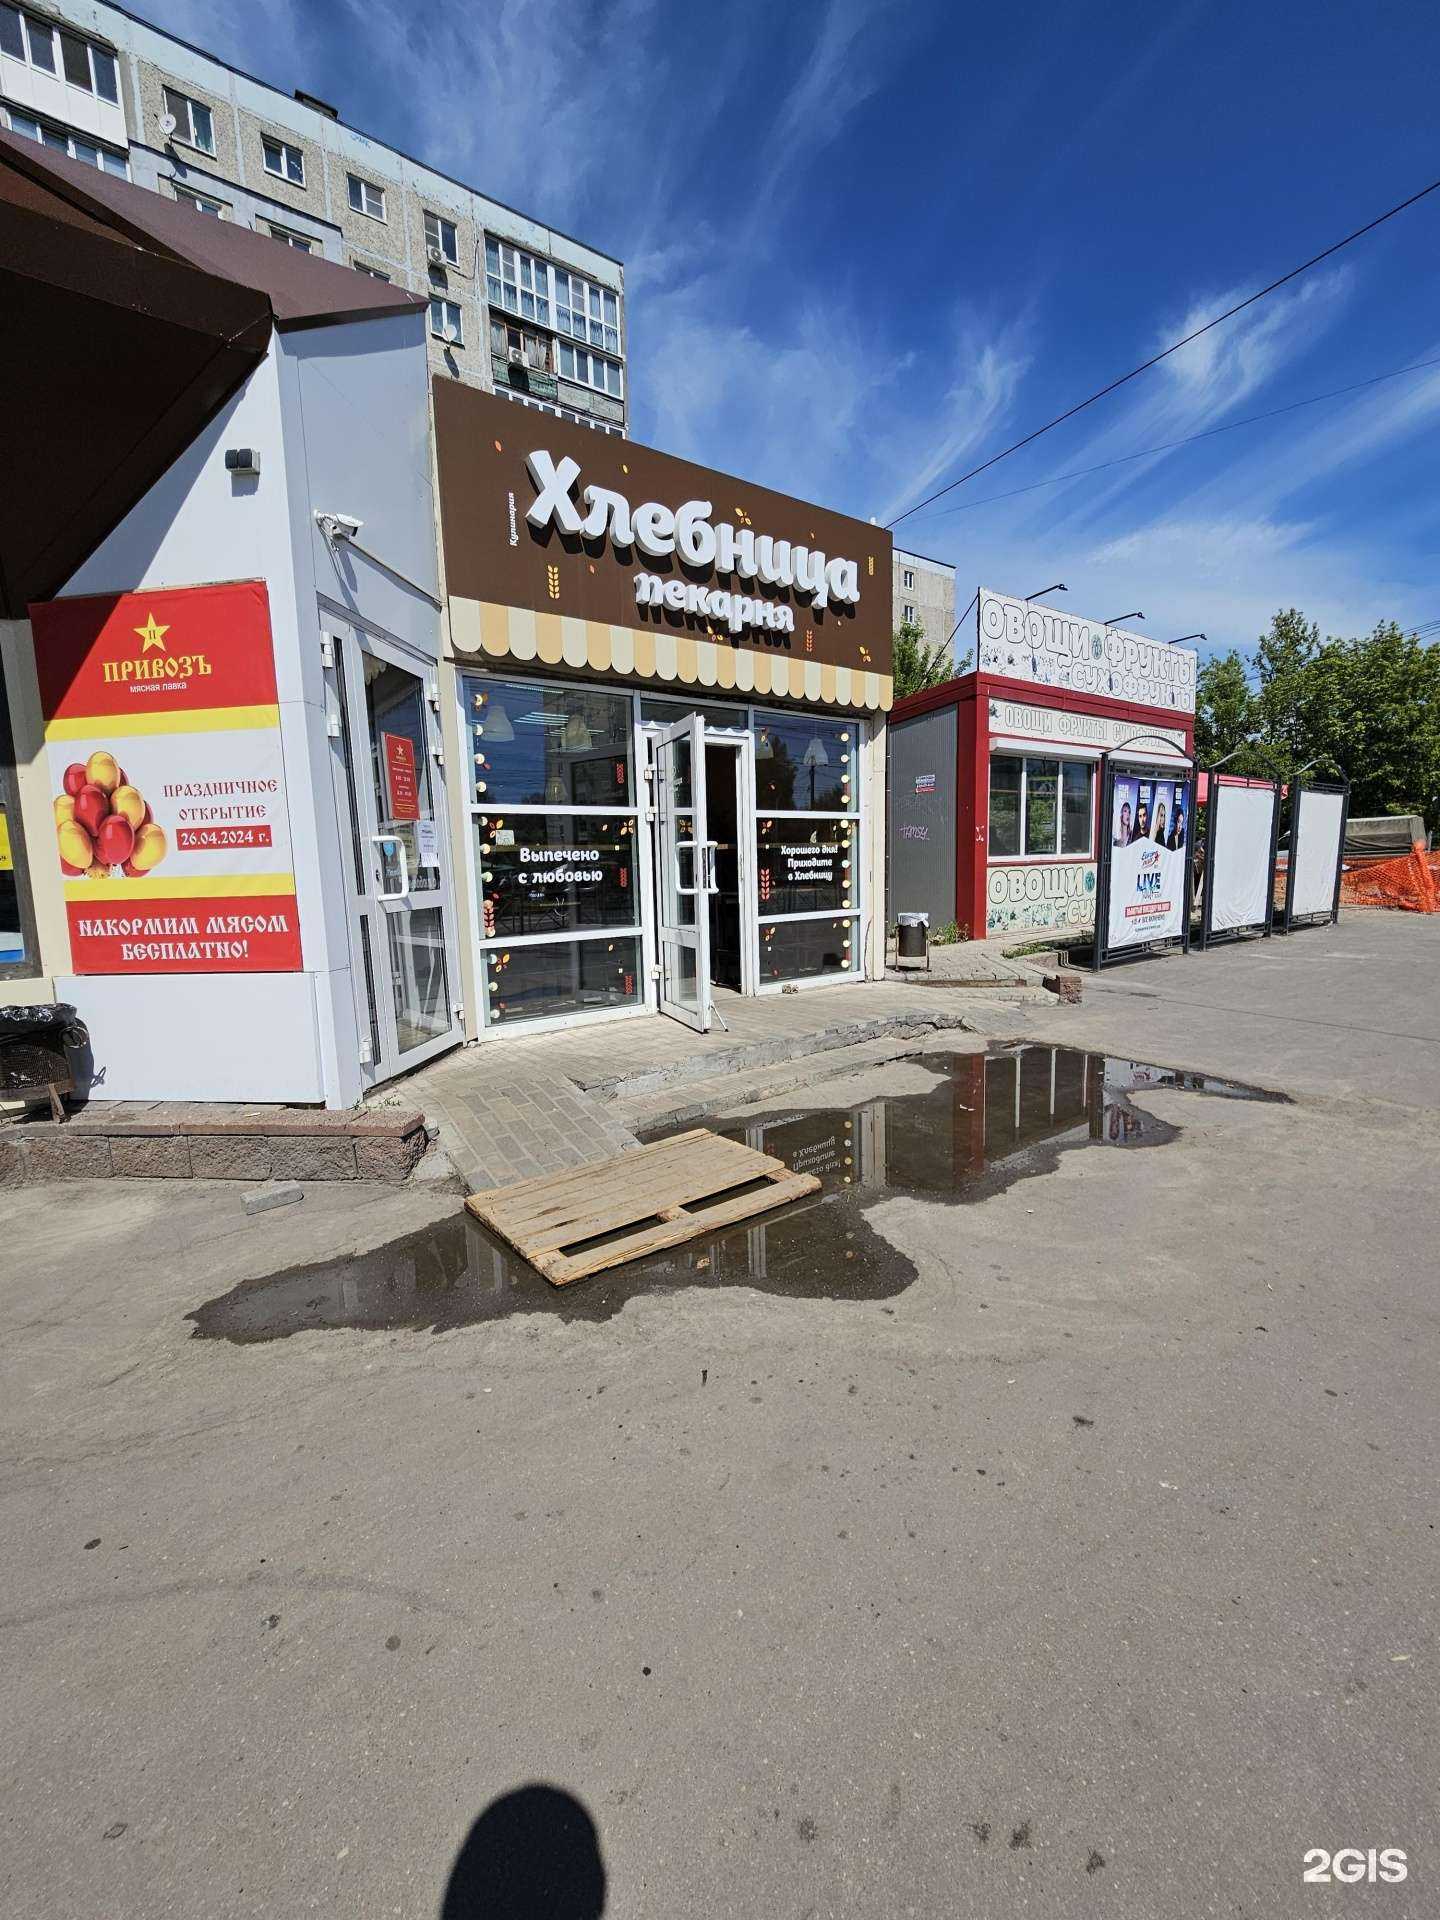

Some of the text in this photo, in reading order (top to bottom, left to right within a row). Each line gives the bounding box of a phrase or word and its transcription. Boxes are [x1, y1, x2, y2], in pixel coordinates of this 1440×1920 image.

[509, 492, 518, 546] Кулинария
[525, 450, 860, 609] Хлебница
[634, 572, 795, 633] пекарня
[982, 599, 1195, 686] ОВОЩИ ФРУКТЫ
[102, 655, 212, 683] ПРИВОЗЪ
[130, 681, 187, 693] мясная лавка
[1071, 662, 1195, 711] СУХОФРУКТЫ
[1005, 706, 1053, 736] ОВОЩИ
[1058, 714, 1108, 740] ФРУКТЫ
[163, 780, 278, 798] ПРАЗДНИЧНОЕ
[179, 804, 266, 821] ОТКРЫТИЕ
[181, 829, 270, 846] 26.04.2024 г.
[520, 847, 600, 862] Выпечено
[781, 844, 838, 857] Хорошего дня!
[787, 857, 833, 870] Приходите
[518, 868, 603, 884] с любовью
[787, 870, 833, 882] в Хлебницу
[1136, 872, 1161, 892] LIVE
[988, 866, 1084, 910] ОВОЩИ
[78, 915, 290, 937] НАКОРМИМ МЯСОМ
[121, 939, 249, 961] БЕСПЛАТНО!
